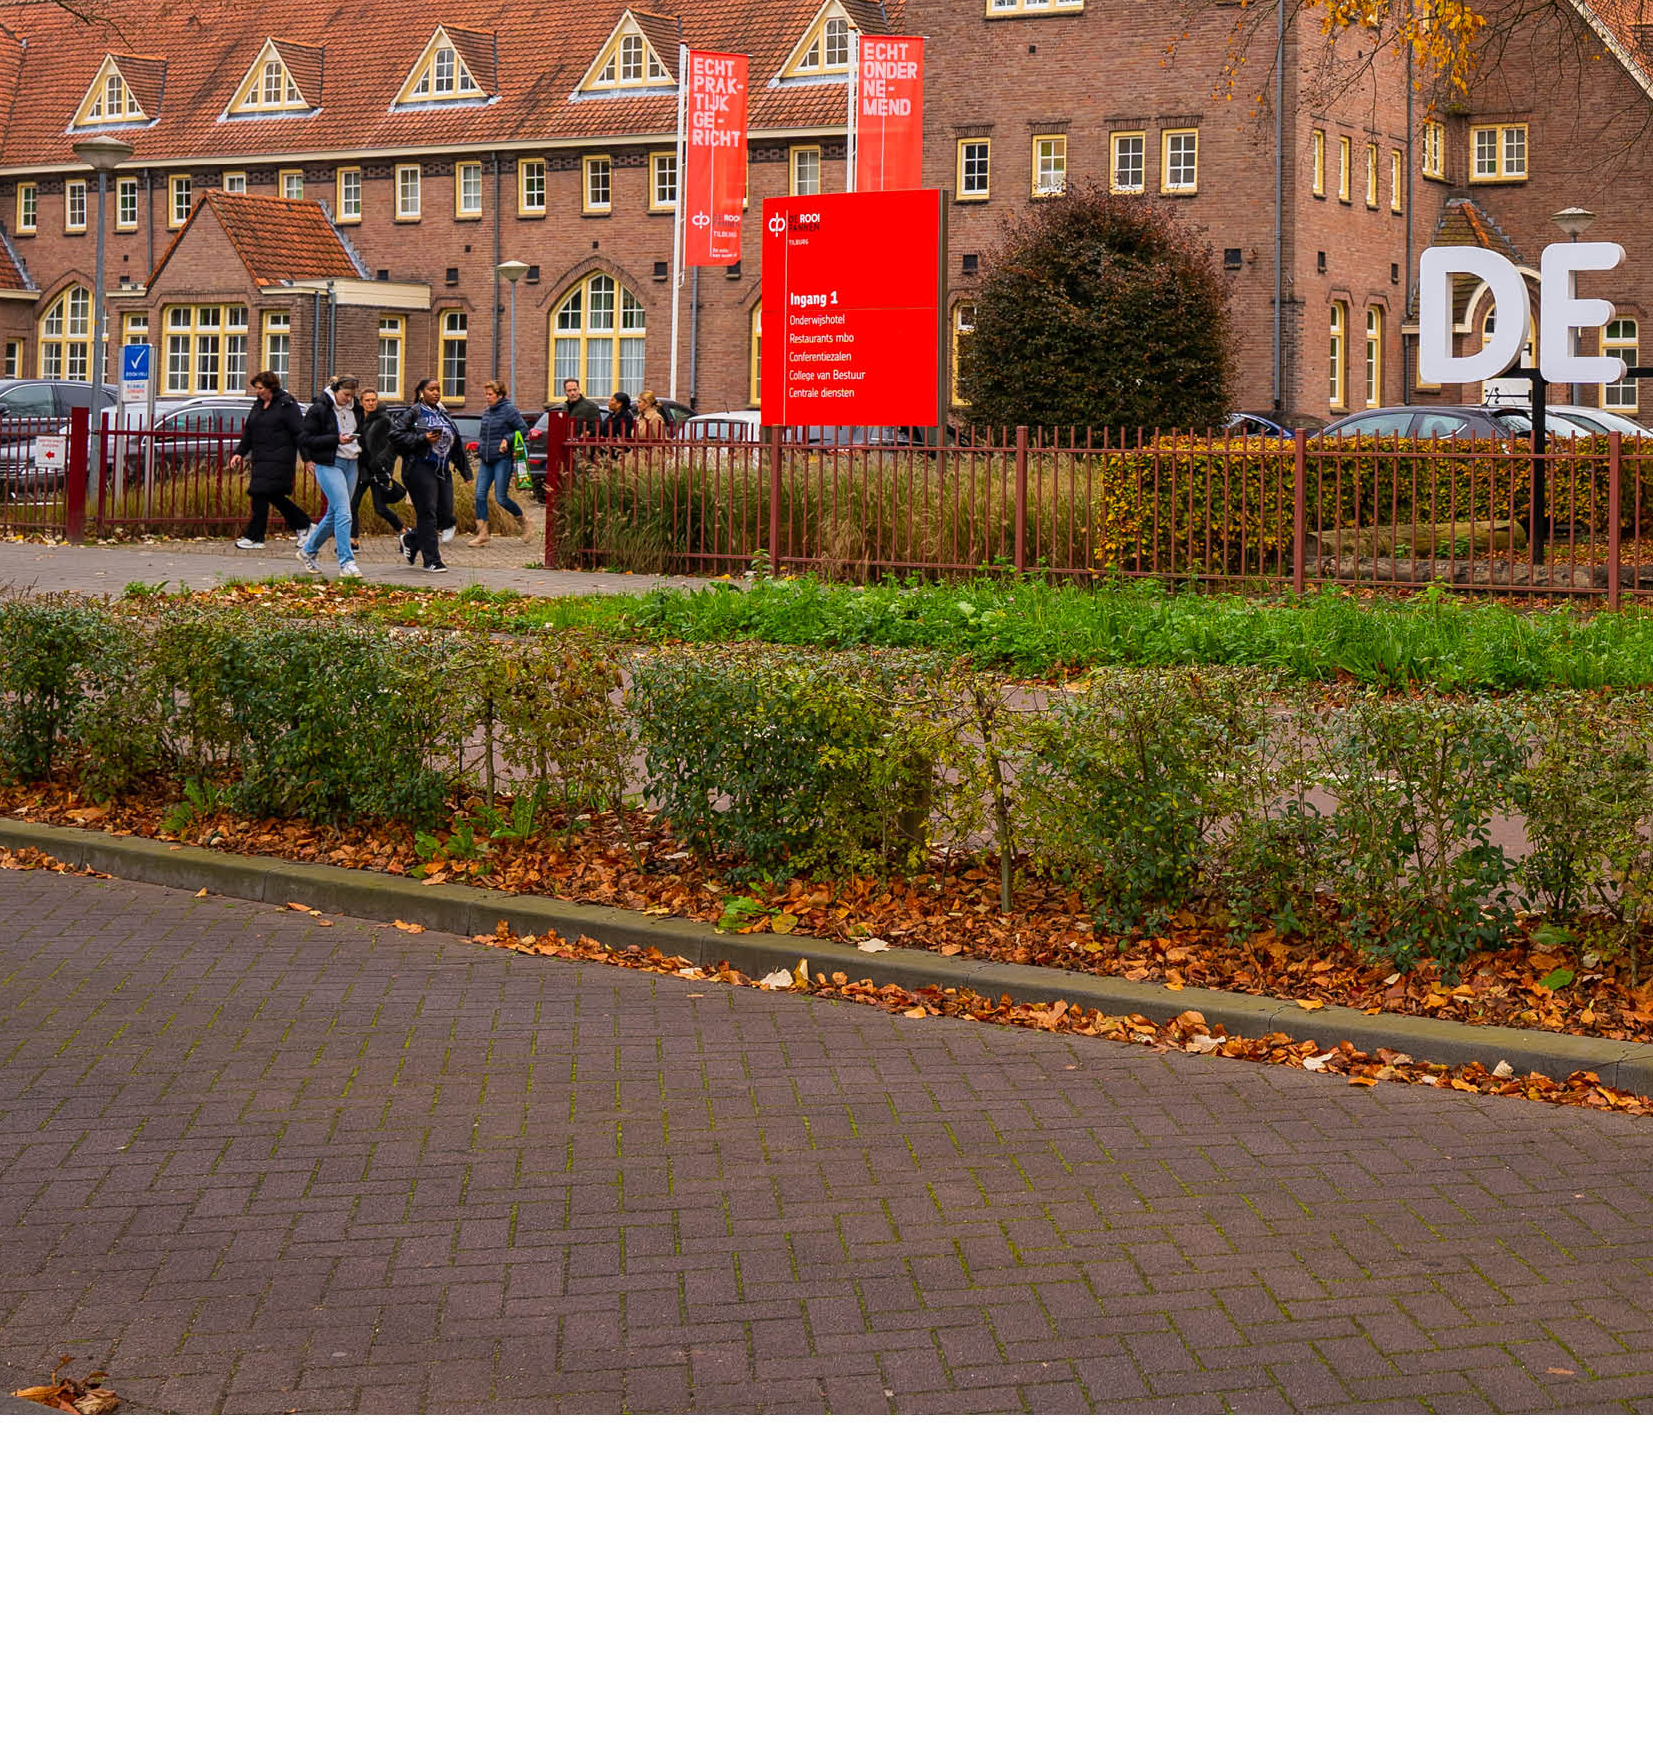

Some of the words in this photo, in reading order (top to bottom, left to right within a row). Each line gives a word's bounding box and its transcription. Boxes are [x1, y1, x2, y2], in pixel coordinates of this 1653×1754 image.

[863, 42, 909, 61] ECHT
[693, 57, 735, 77] ECHT
[863, 60, 918, 79] ONDER
[693, 75, 744, 95] PRAK-
[693, 93, 730, 111] TIJK
[862, 98, 912, 116] MEND
[691, 128, 741, 148] RICHT
[799, 213, 820, 223] ROOI
[790, 291, 827, 308] Ingang
[830, 290, 838, 304] 1
[789, 313, 846, 326] Onderwijshotel
[1419, 241, 1629, 384] DE
[789, 333, 834, 344] Restaurants
[836, 331, 855, 343] mbo
[789, 350, 852, 362] Conferentiezalen
[789, 369, 815, 382] College
[816, 371, 831, 380] van
[832, 368, 866, 380] Bestuur
[788, 386, 819, 398] Centrale
[820, 386, 855, 398] diensten
